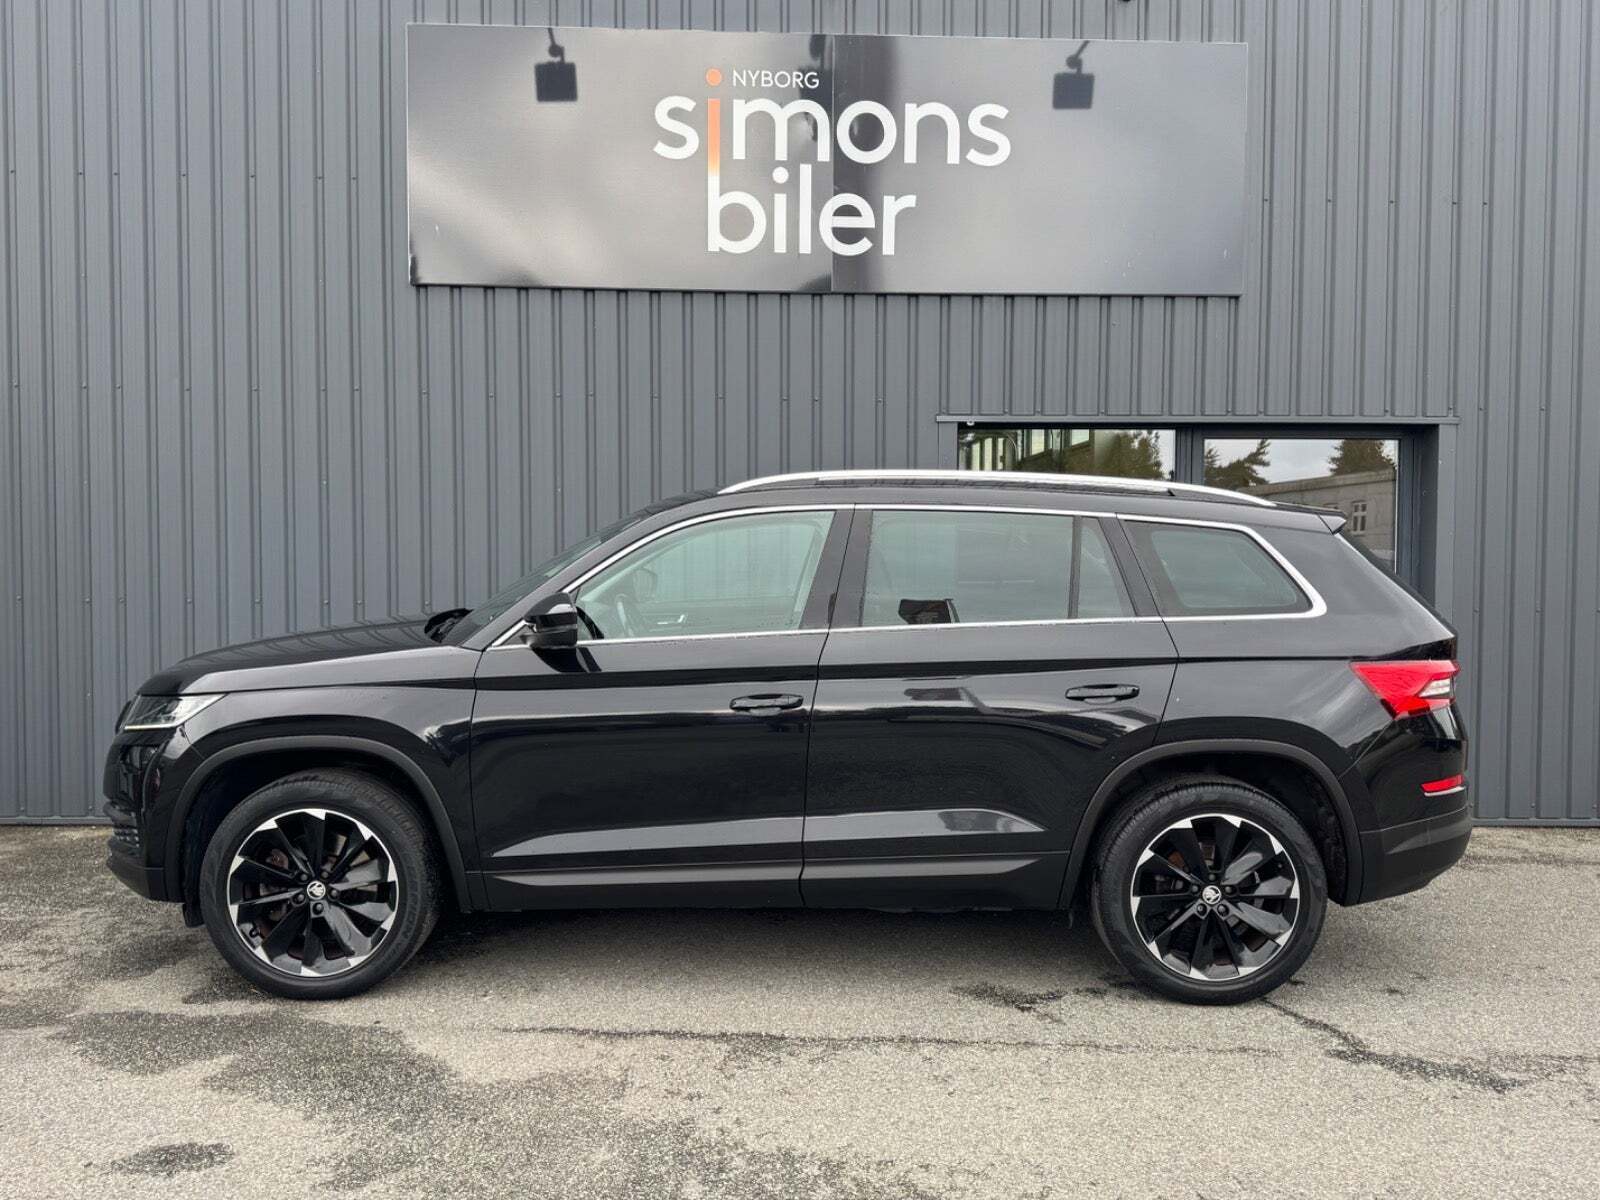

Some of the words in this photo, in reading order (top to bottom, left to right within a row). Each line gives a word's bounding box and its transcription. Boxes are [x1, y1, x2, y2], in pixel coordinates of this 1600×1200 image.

[653, 68, 1012, 167] simons
[732, 69, 820, 89] NYBORG
[707, 163, 917, 257] biler
